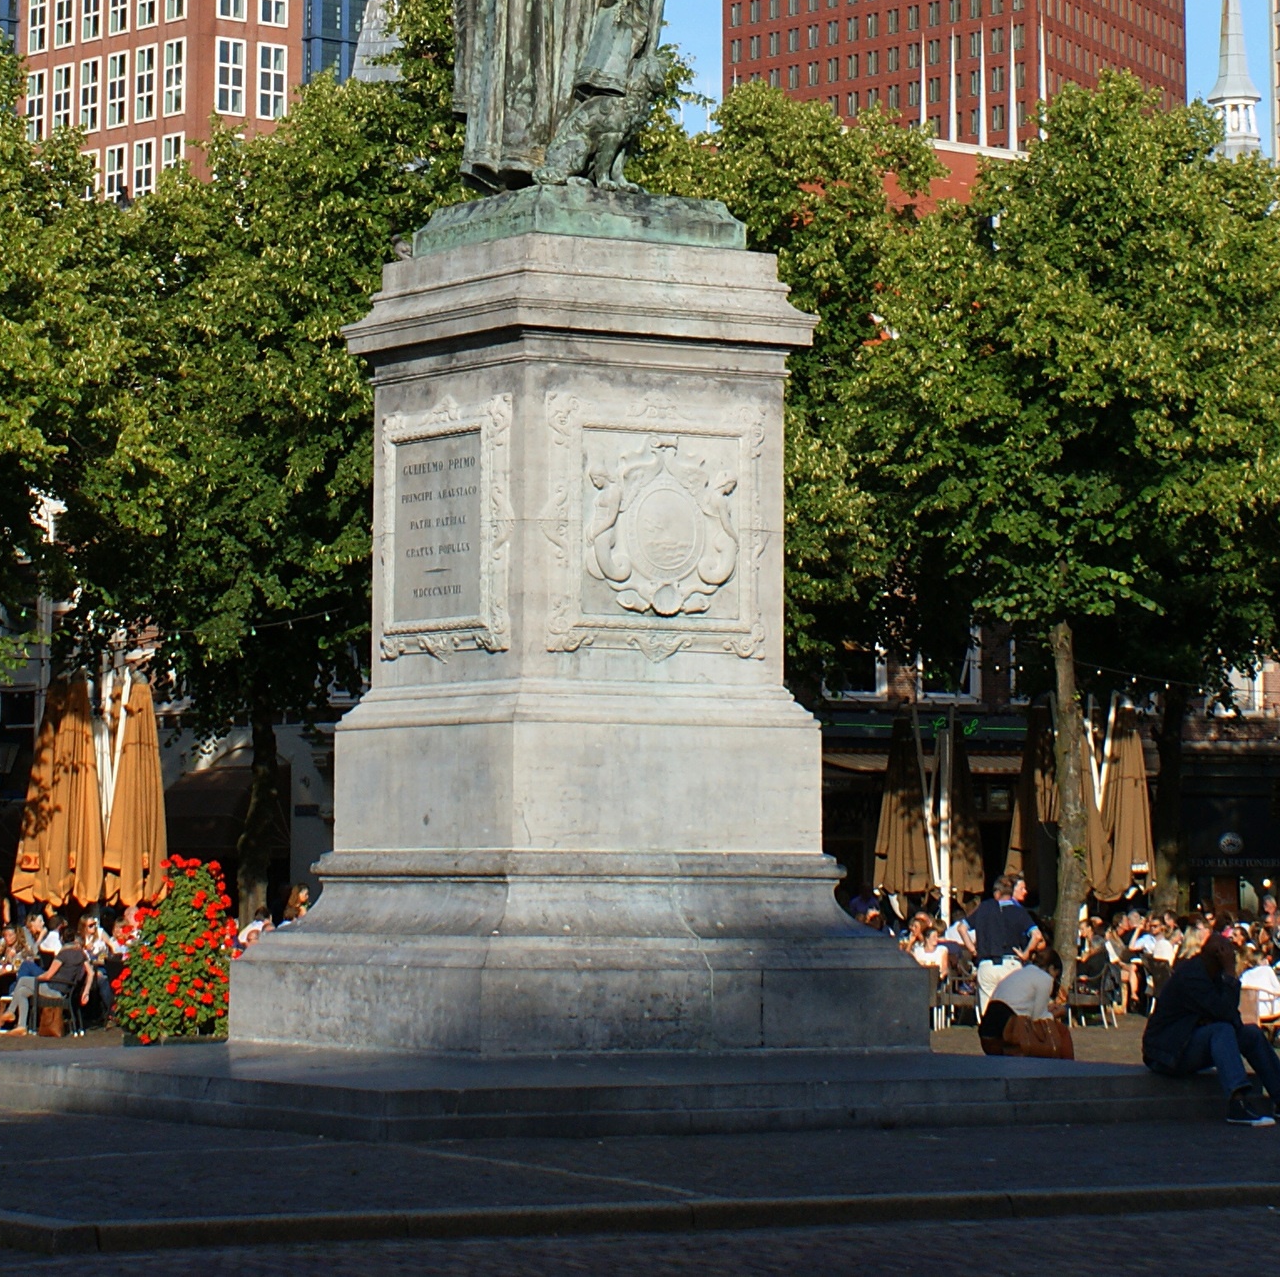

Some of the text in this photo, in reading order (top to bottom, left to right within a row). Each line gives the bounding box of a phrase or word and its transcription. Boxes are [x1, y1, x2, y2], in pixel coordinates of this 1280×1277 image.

[403, 456, 476, 476] GULIELMO PRIMO
[401, 491, 433, 504] PRINCIPI
[410, 519, 432, 530] PATRI
[406, 542, 470, 558] GRATUS POPULUS
